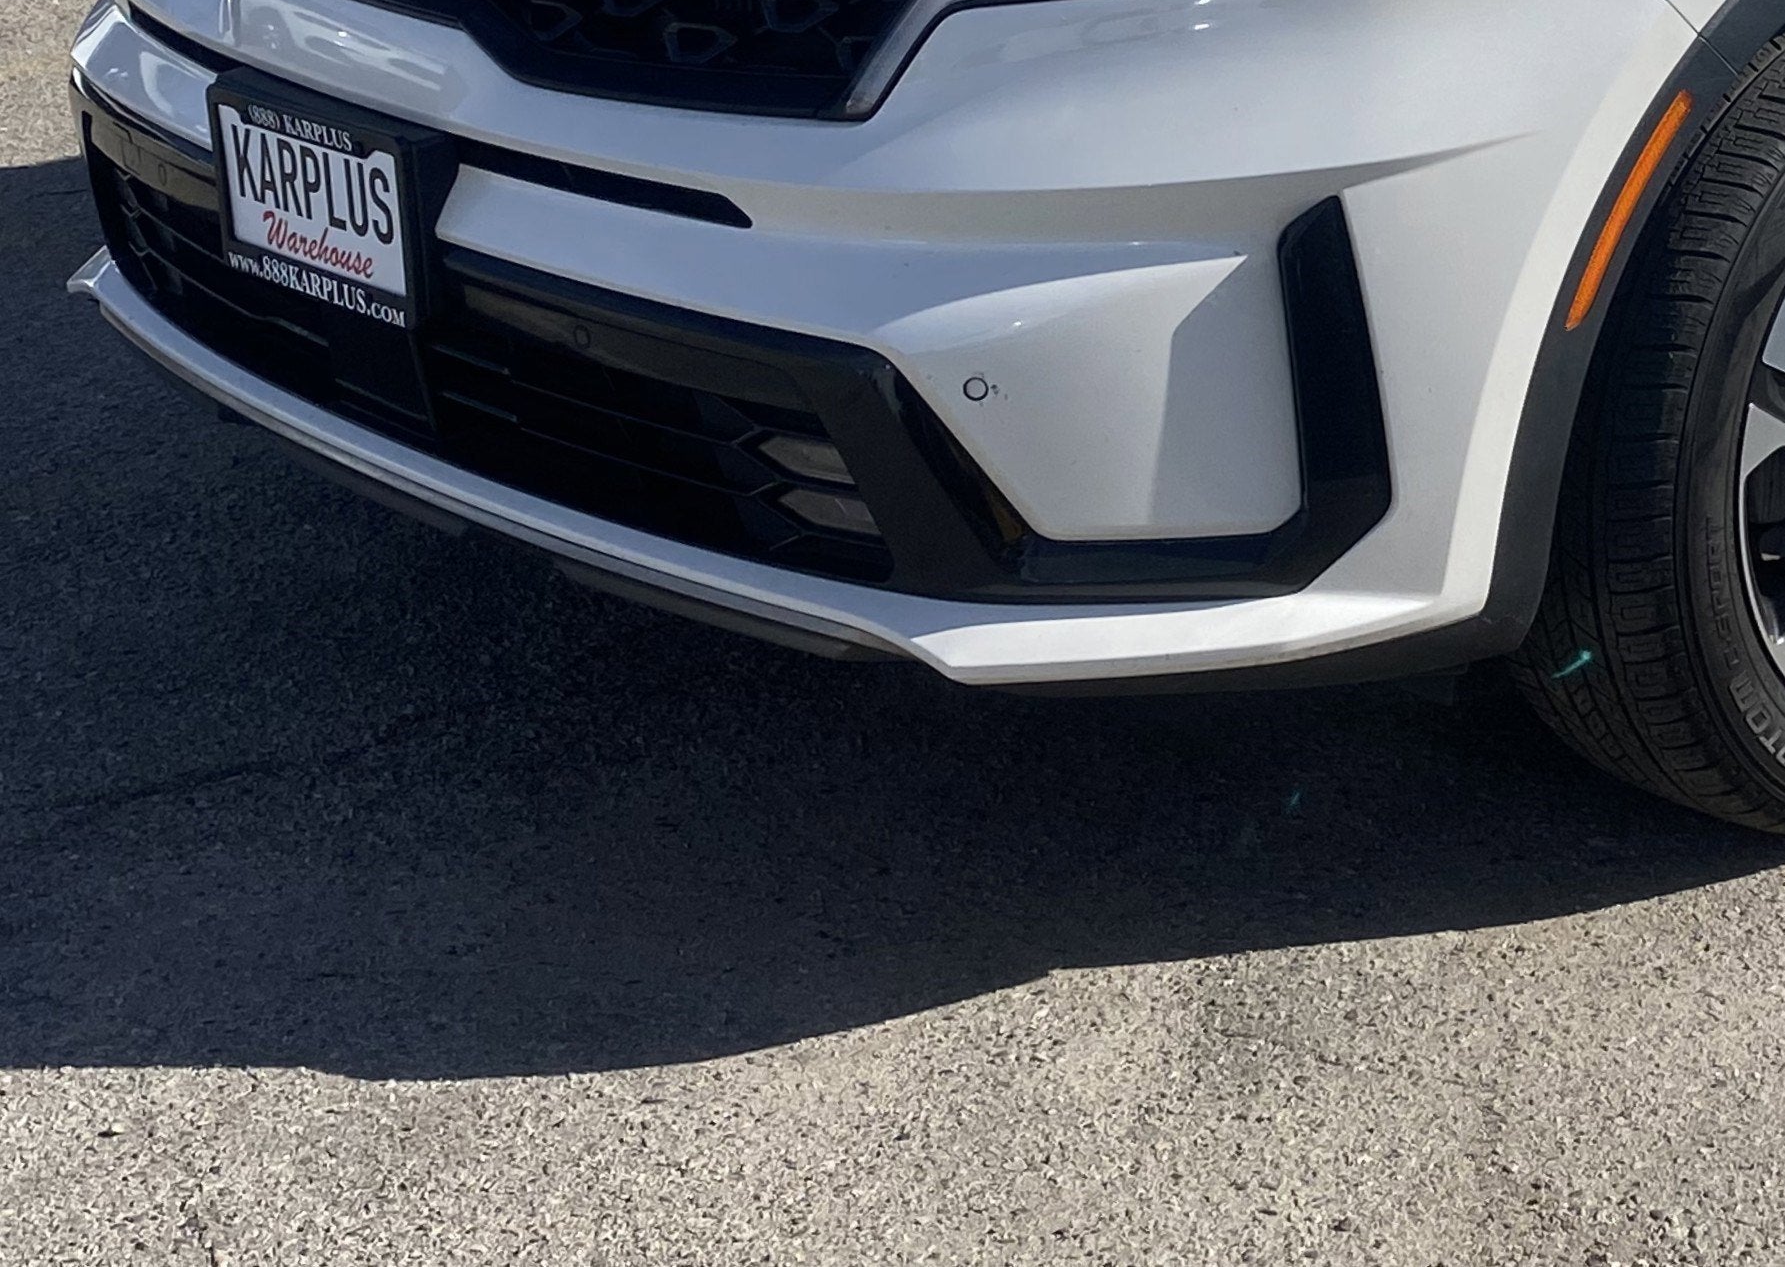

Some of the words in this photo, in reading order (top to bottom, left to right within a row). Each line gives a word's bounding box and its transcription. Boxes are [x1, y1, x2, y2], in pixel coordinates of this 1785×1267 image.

[248, 104, 280, 131] (888)
[283, 114, 353, 152] KARPLUS
[230, 123, 395, 246] KARPLUS
[262, 209, 374, 280] Warehouse
